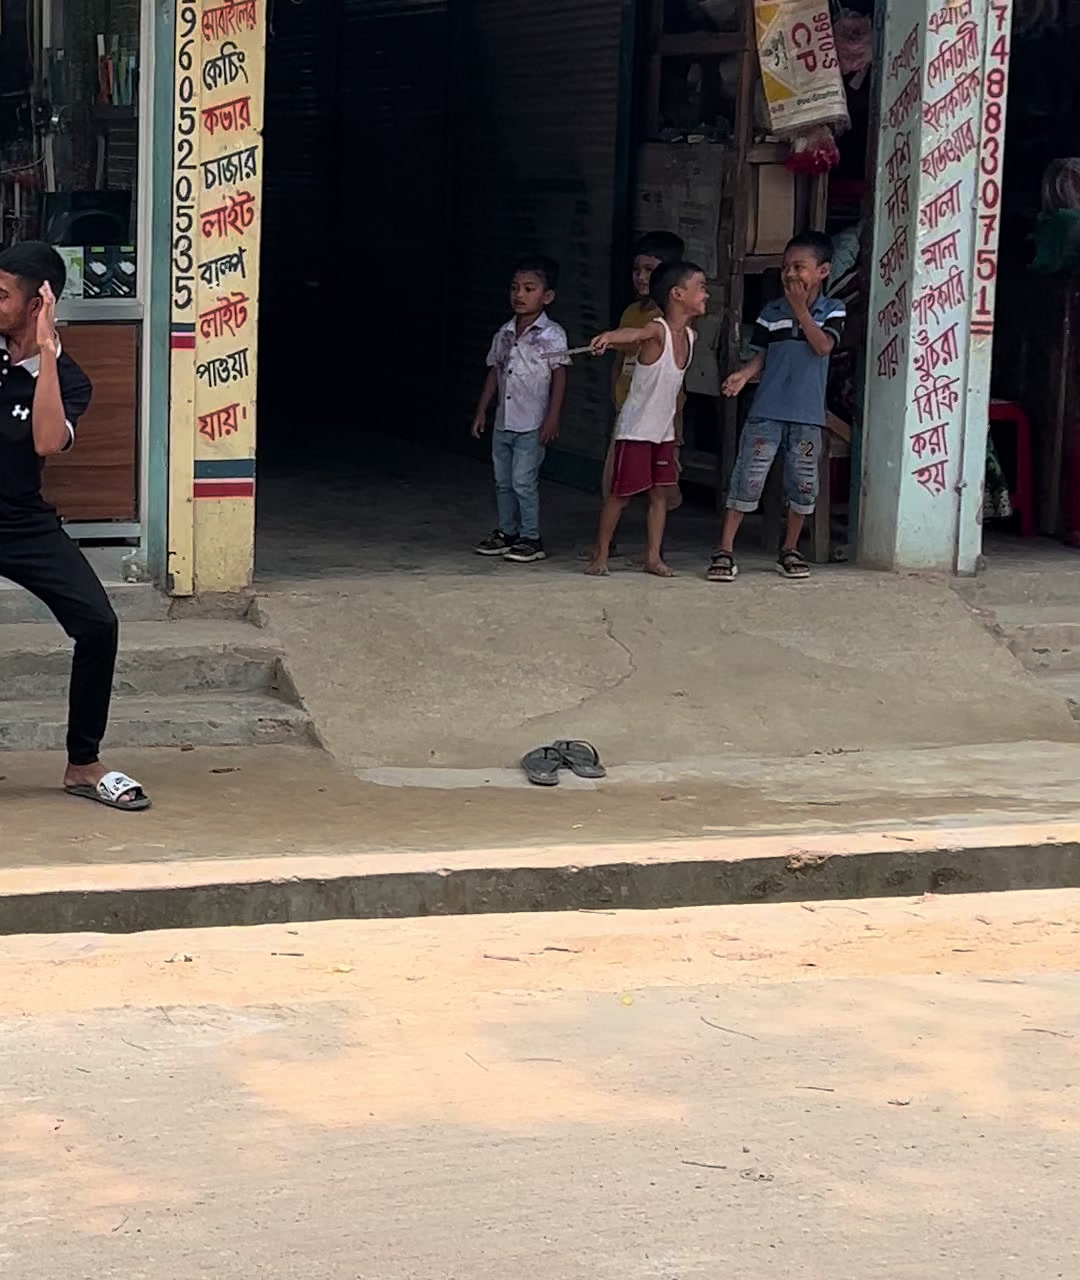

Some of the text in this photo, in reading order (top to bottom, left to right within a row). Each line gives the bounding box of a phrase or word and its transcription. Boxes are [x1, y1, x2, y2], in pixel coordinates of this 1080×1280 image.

[791, 22, 817, 73] CP
[201, 96, 251, 136] কভার
[199, 190, 255, 240] লাইট
[199, 291, 251, 340] লাইট
[196, 348, 249, 388] পাওয়া
[909, 422, 949, 459] করা
[911, 459, 949, 498] হয়
